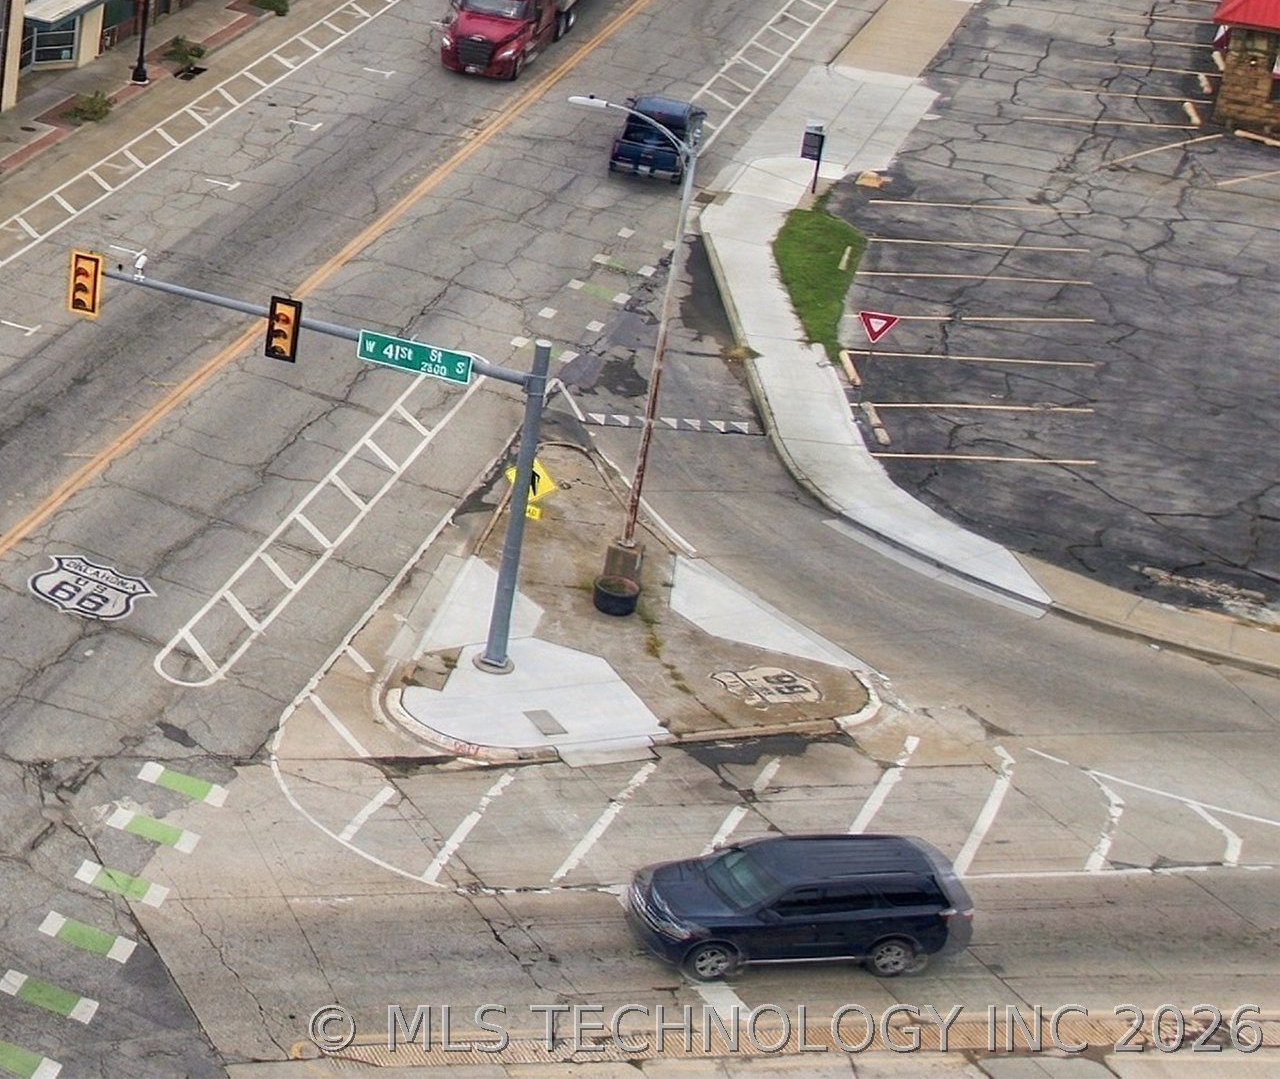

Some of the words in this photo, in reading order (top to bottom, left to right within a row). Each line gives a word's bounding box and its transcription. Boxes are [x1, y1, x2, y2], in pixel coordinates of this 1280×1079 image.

[365, 340, 376, 352] W
[430, 349, 443, 363] St
[455, 362, 466, 374] S
[66, 560, 137, 592] OKLAHOMA
[48, 581, 110, 612] 66
